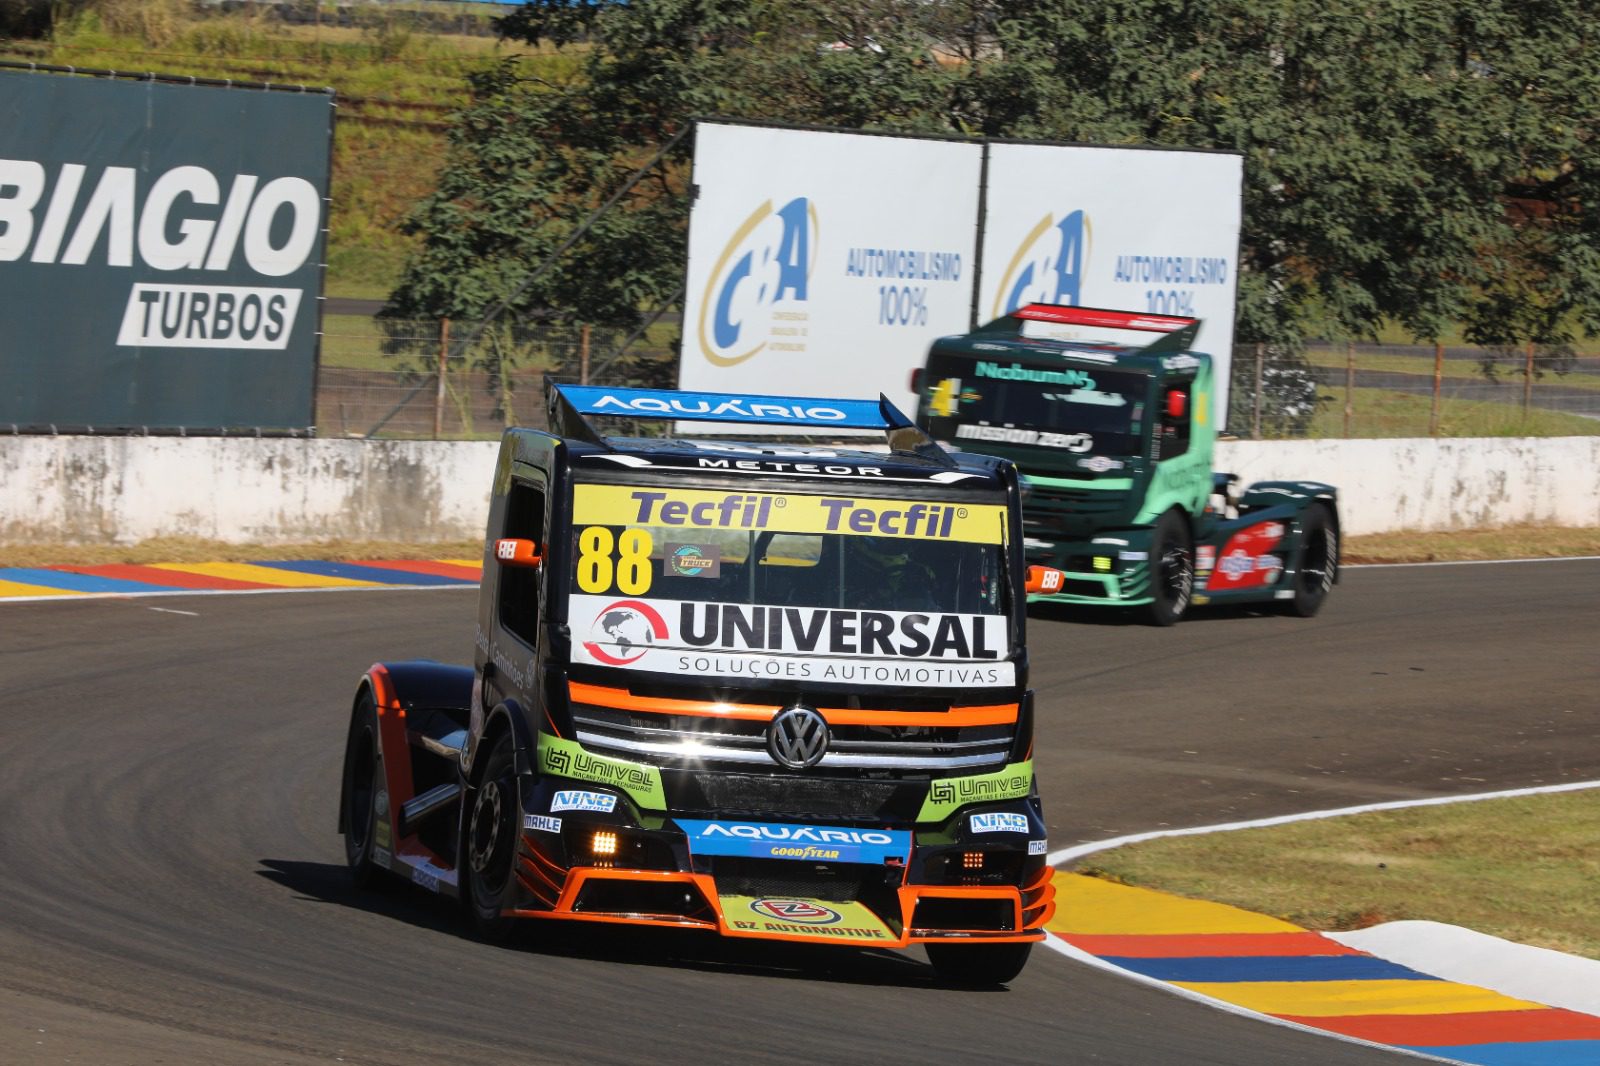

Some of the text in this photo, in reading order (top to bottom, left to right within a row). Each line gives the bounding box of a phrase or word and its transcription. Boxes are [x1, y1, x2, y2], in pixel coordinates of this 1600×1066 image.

[846, 248, 961, 281] AUTOMOBILISMO
[1114, 255, 1228, 284] AUTOMOBILISMO
[138, 290, 287, 341] TURBOS
[879, 285, 928, 326] 100%
[592, 395, 847, 420] AQUÁRIO
[698, 458, 884, 476] METEOR
[498, 541, 517, 559] 88
[577, 526, 653, 595] 88
[1041, 571, 1059, 588] 88
[680, 602, 998, 659] UNIVERSAL
[679, 655, 998, 683] SOLUÇÕES AUTOMOTIVAS
[525, 815, 561, 831] MAHLE
[702, 823, 892, 845] AQUÁRIO
[771, 847, 839, 859] GOODYEAR
[733, 920, 886, 939] BZ AUTOMOTIVE
